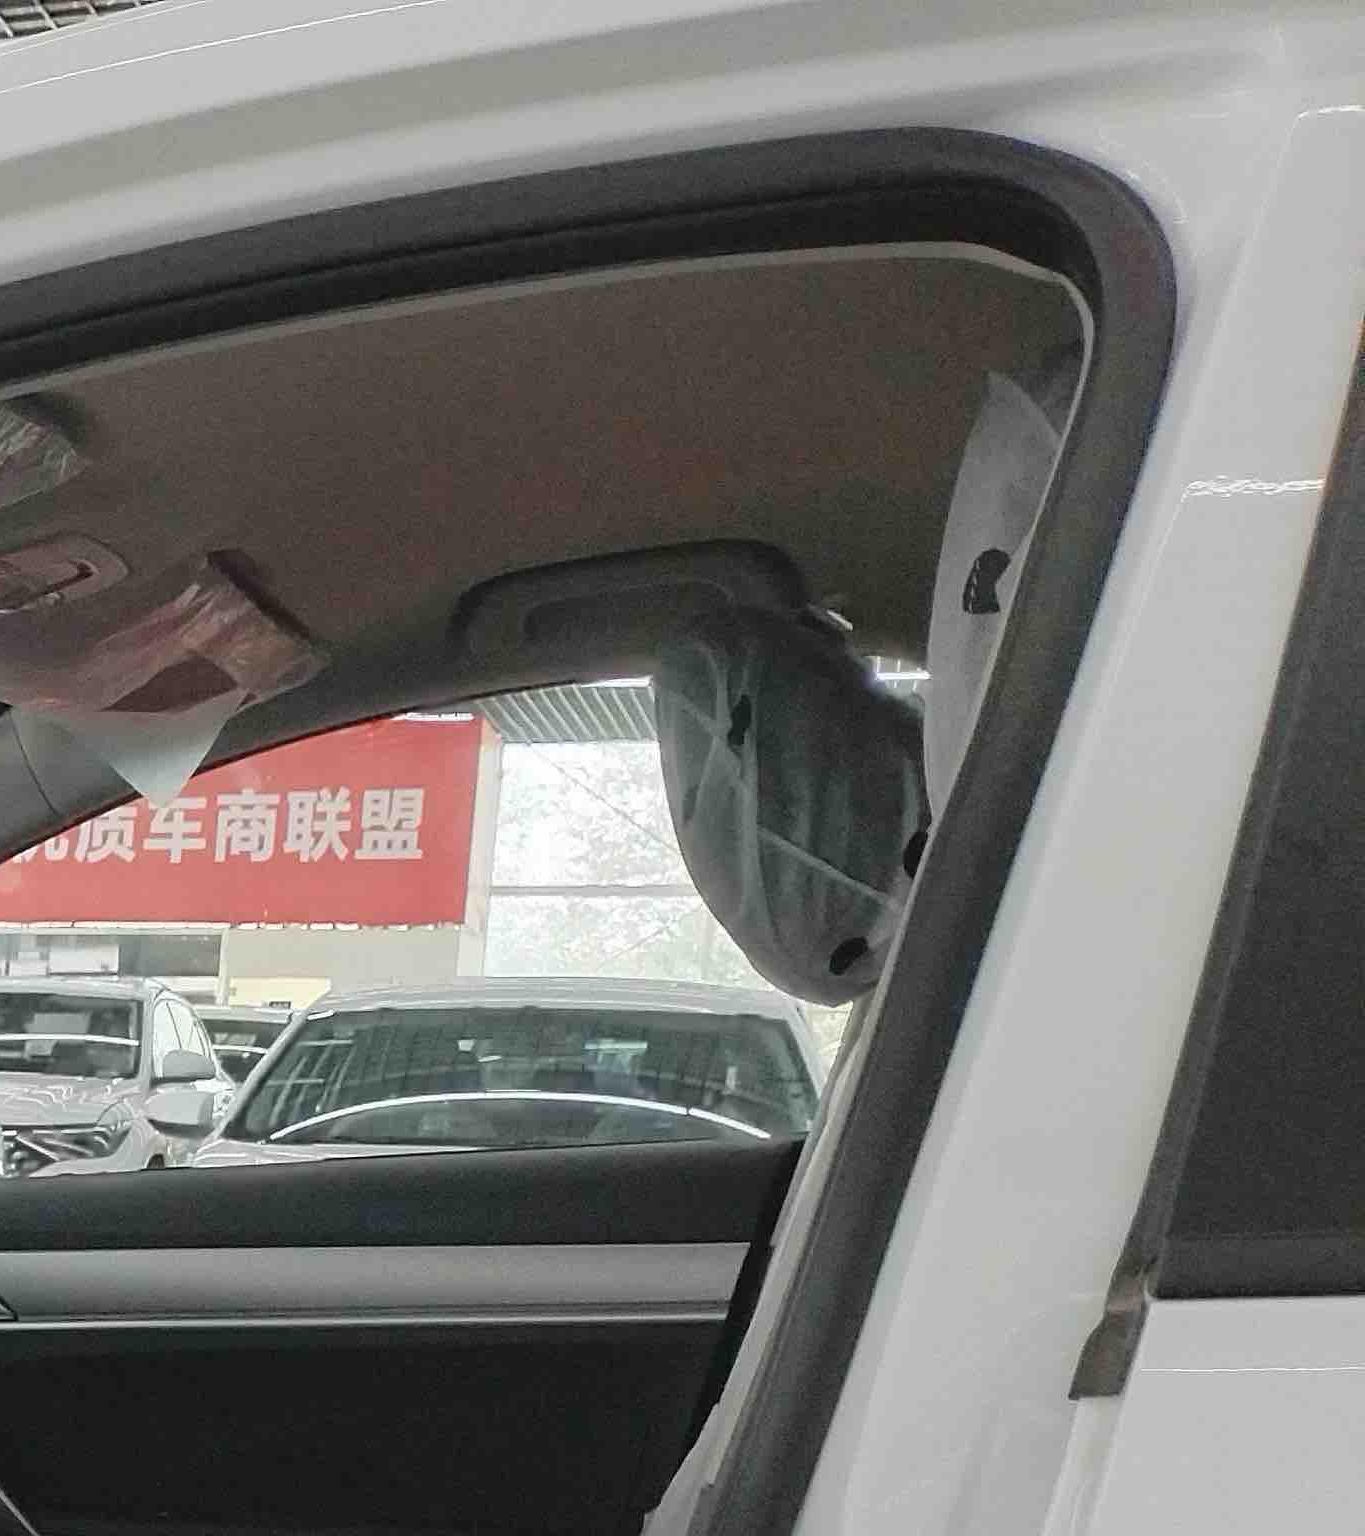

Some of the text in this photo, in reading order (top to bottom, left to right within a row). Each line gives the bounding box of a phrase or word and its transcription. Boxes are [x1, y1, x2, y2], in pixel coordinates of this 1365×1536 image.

[12, 787, 425, 864] 质车商联盟
